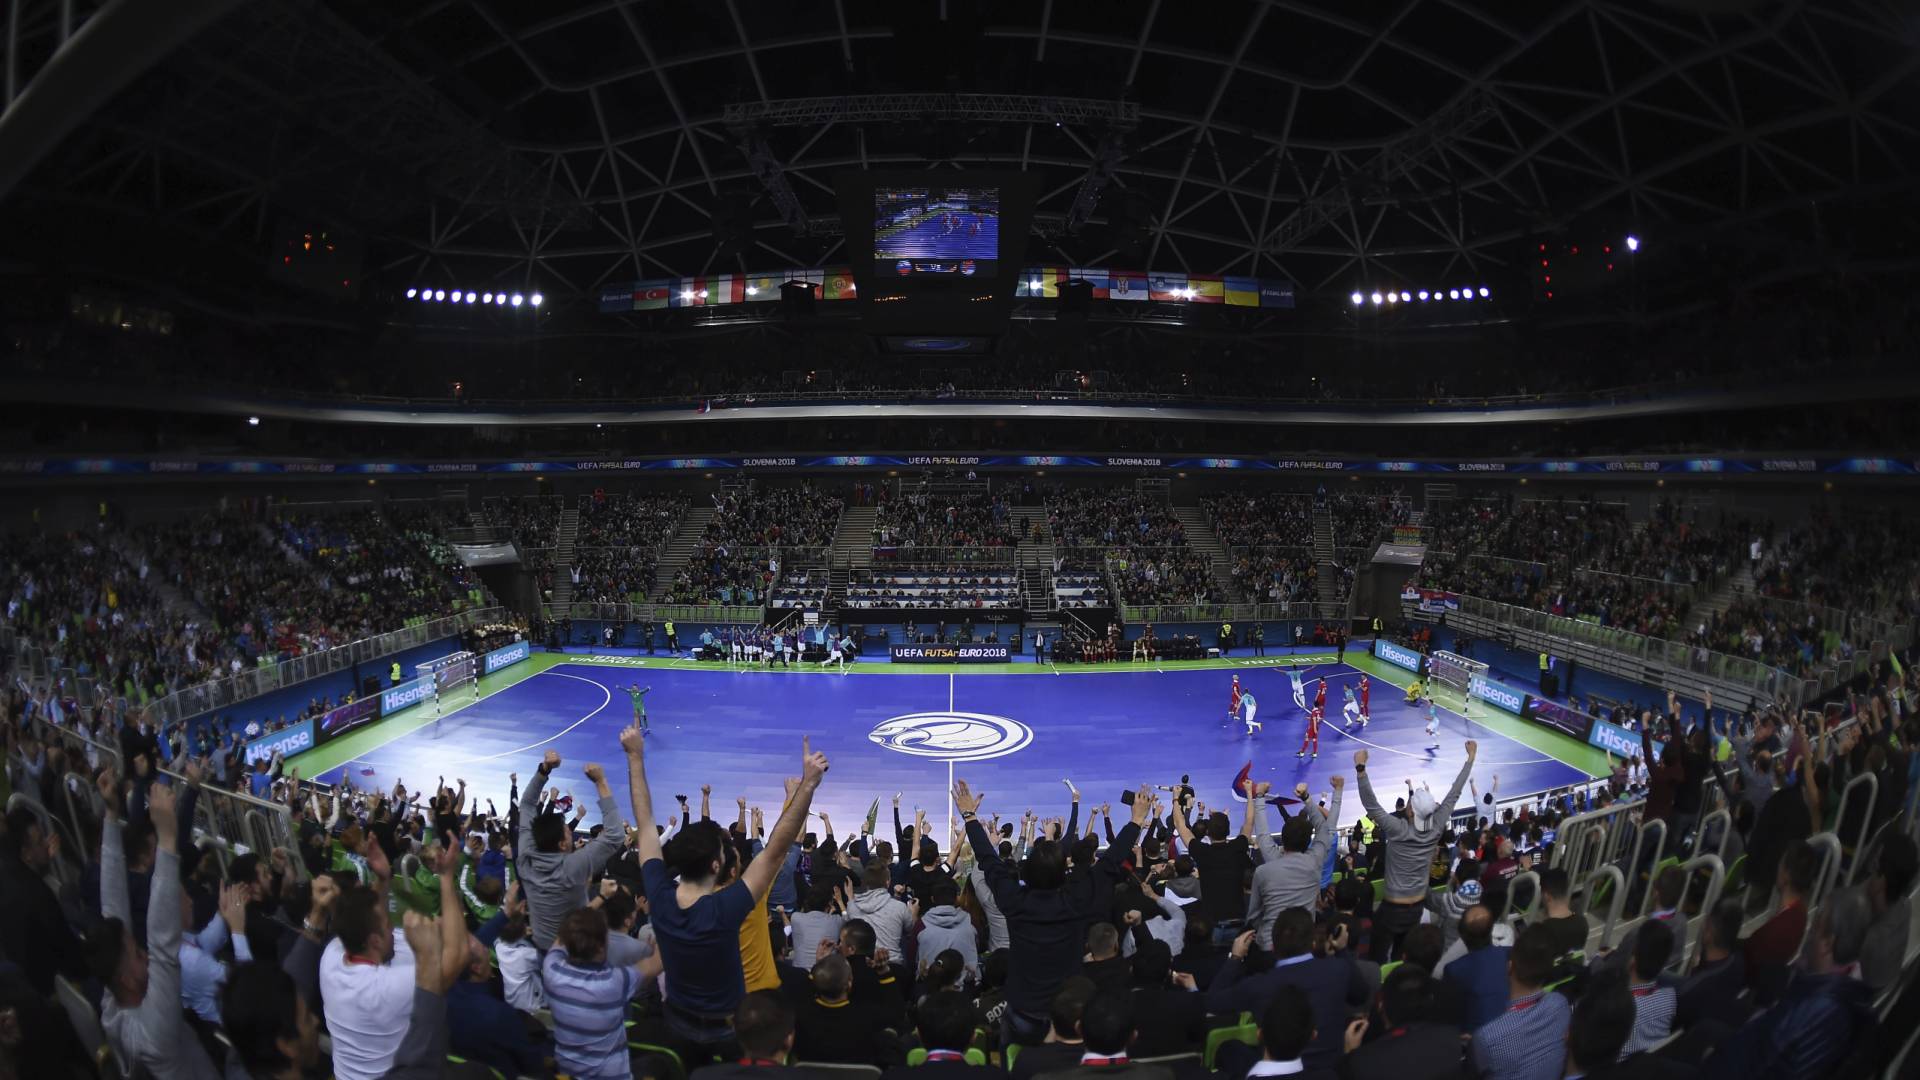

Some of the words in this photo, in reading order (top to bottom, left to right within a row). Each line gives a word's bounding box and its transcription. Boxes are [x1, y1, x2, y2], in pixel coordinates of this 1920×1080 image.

[577, 462, 598, 470] UEFA
[743, 458, 777, 466] SLOVENIA
[777, 458, 796, 466] 2018
[908, 457, 931, 465] UEFA
[959, 457, 979, 465] EURO
[1108, 458, 1142, 466] SLOVENIA
[1143, 458, 1161, 466] 2018
[1278, 461, 1299, 469] UEFA
[895, 648, 923, 658] UEFA
[958, 648, 983, 658] EURO
[983, 648, 1007, 658] 2018
[1381, 643, 1417, 669] Hisense
[488, 648, 523, 669] Hisense
[570, 656, 648, 666] SLOVENIA
[385, 683, 433, 711] Hisense
[1472, 678, 1520, 709] Hisense
[246, 731, 310, 766] Hisense
